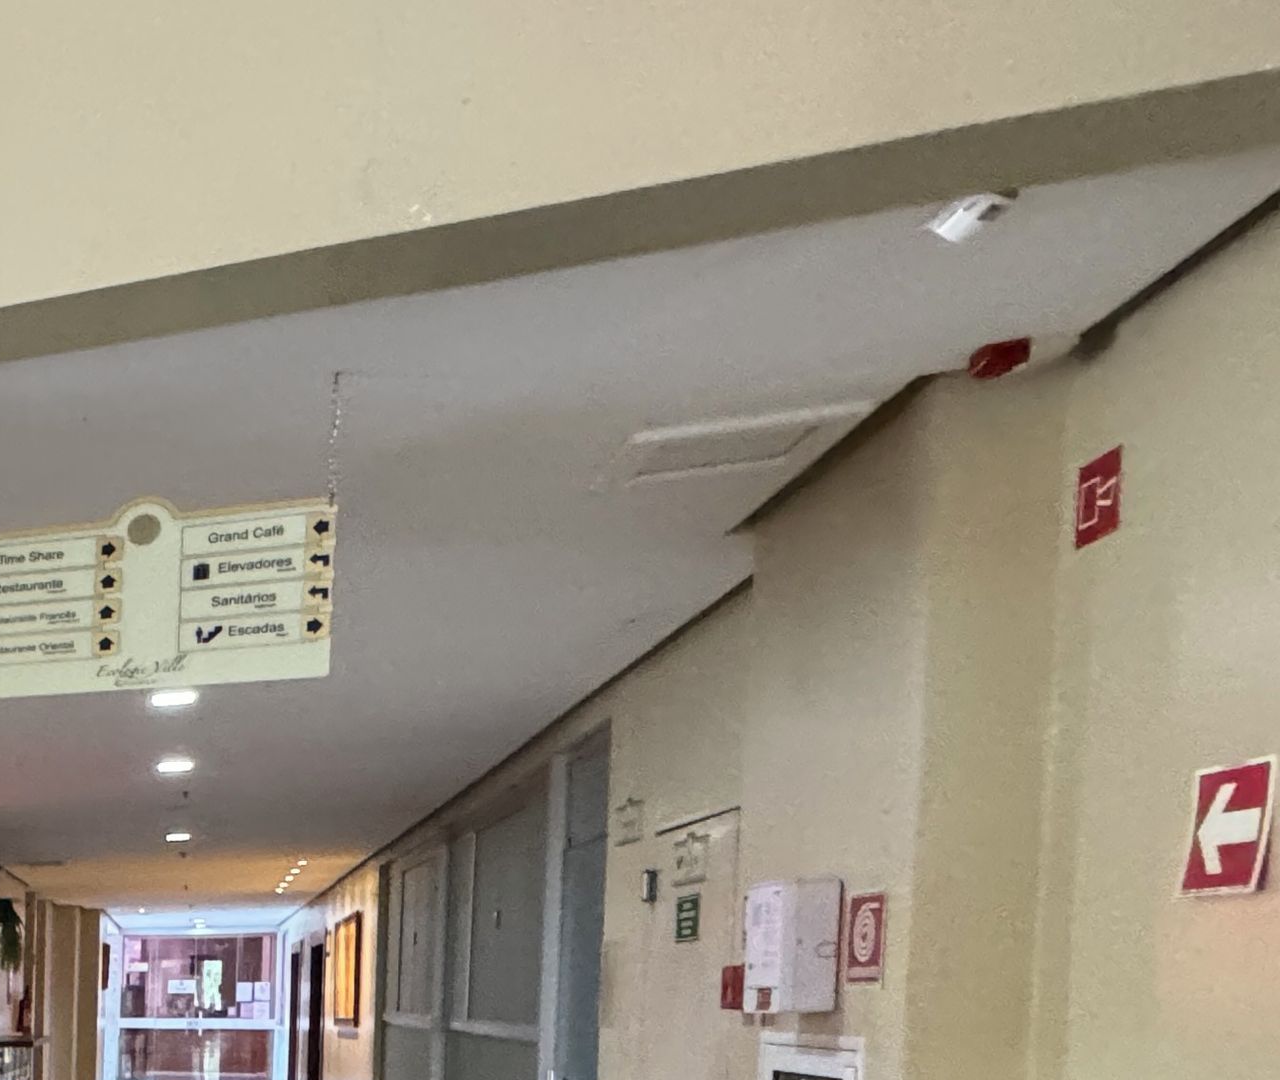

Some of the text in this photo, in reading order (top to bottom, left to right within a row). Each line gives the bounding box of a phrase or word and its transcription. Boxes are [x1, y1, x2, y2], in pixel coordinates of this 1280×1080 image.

[208, 525, 285, 544] Grand Café
[29, 550, 65, 562] Share
[217, 557, 293, 574] Elevadores
[210, 592, 277, 608] Sanitários
[227, 622, 285, 637] Escadas
